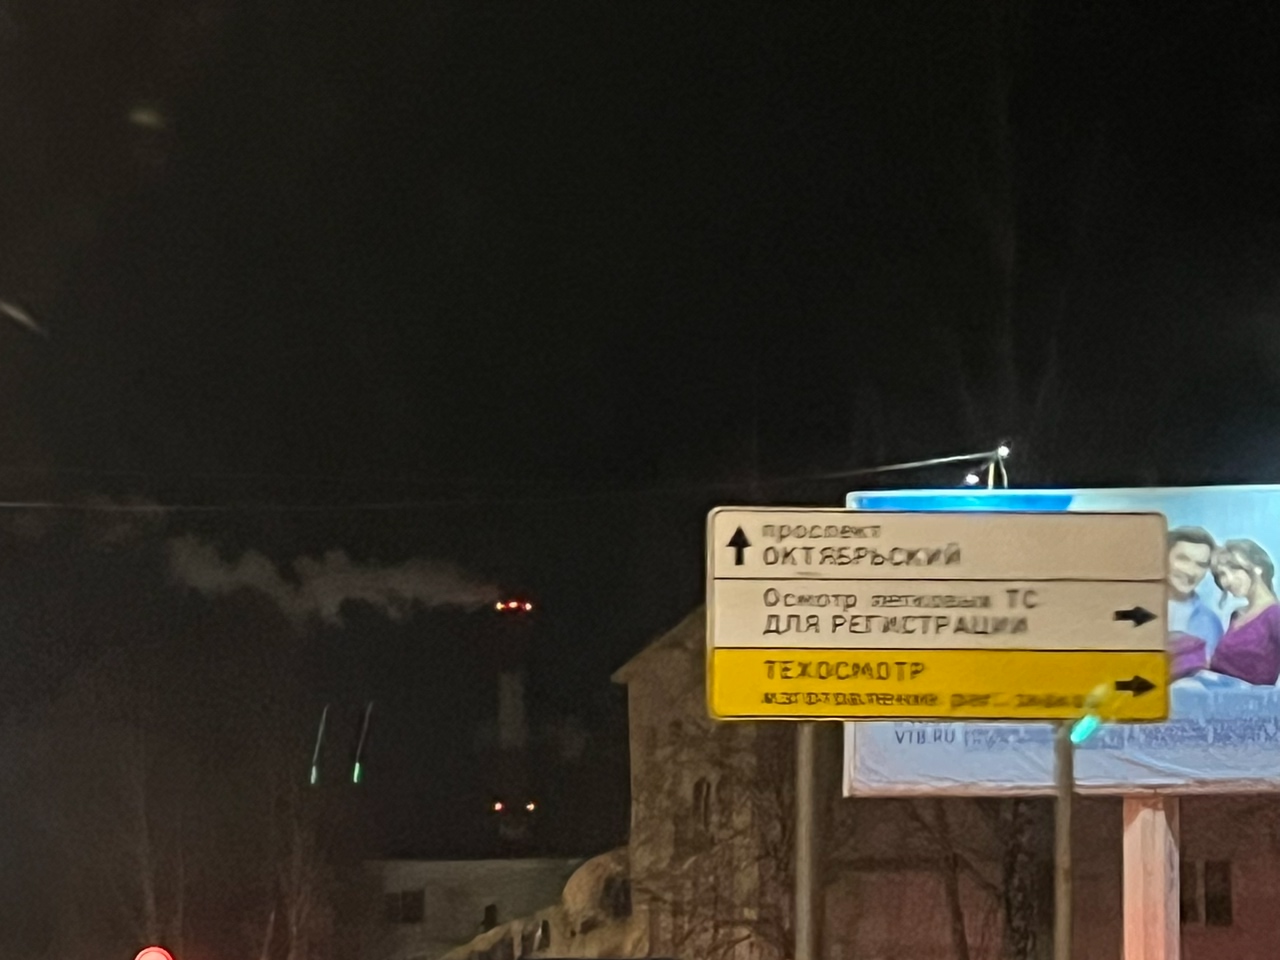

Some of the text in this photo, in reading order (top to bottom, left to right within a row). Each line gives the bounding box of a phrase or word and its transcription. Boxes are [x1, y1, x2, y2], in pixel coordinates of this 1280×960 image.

[762, 541, 961, 566] ОКТЯБРЬСКИЙ
[762, 587, 858, 611] Осмотр
[1005, 588, 1039, 609] ТС
[762, 613, 1029, 635] ДЛЯ РЕГИСТРАЦИИ
[763, 659, 925, 682] ТЕХОСМОТР
